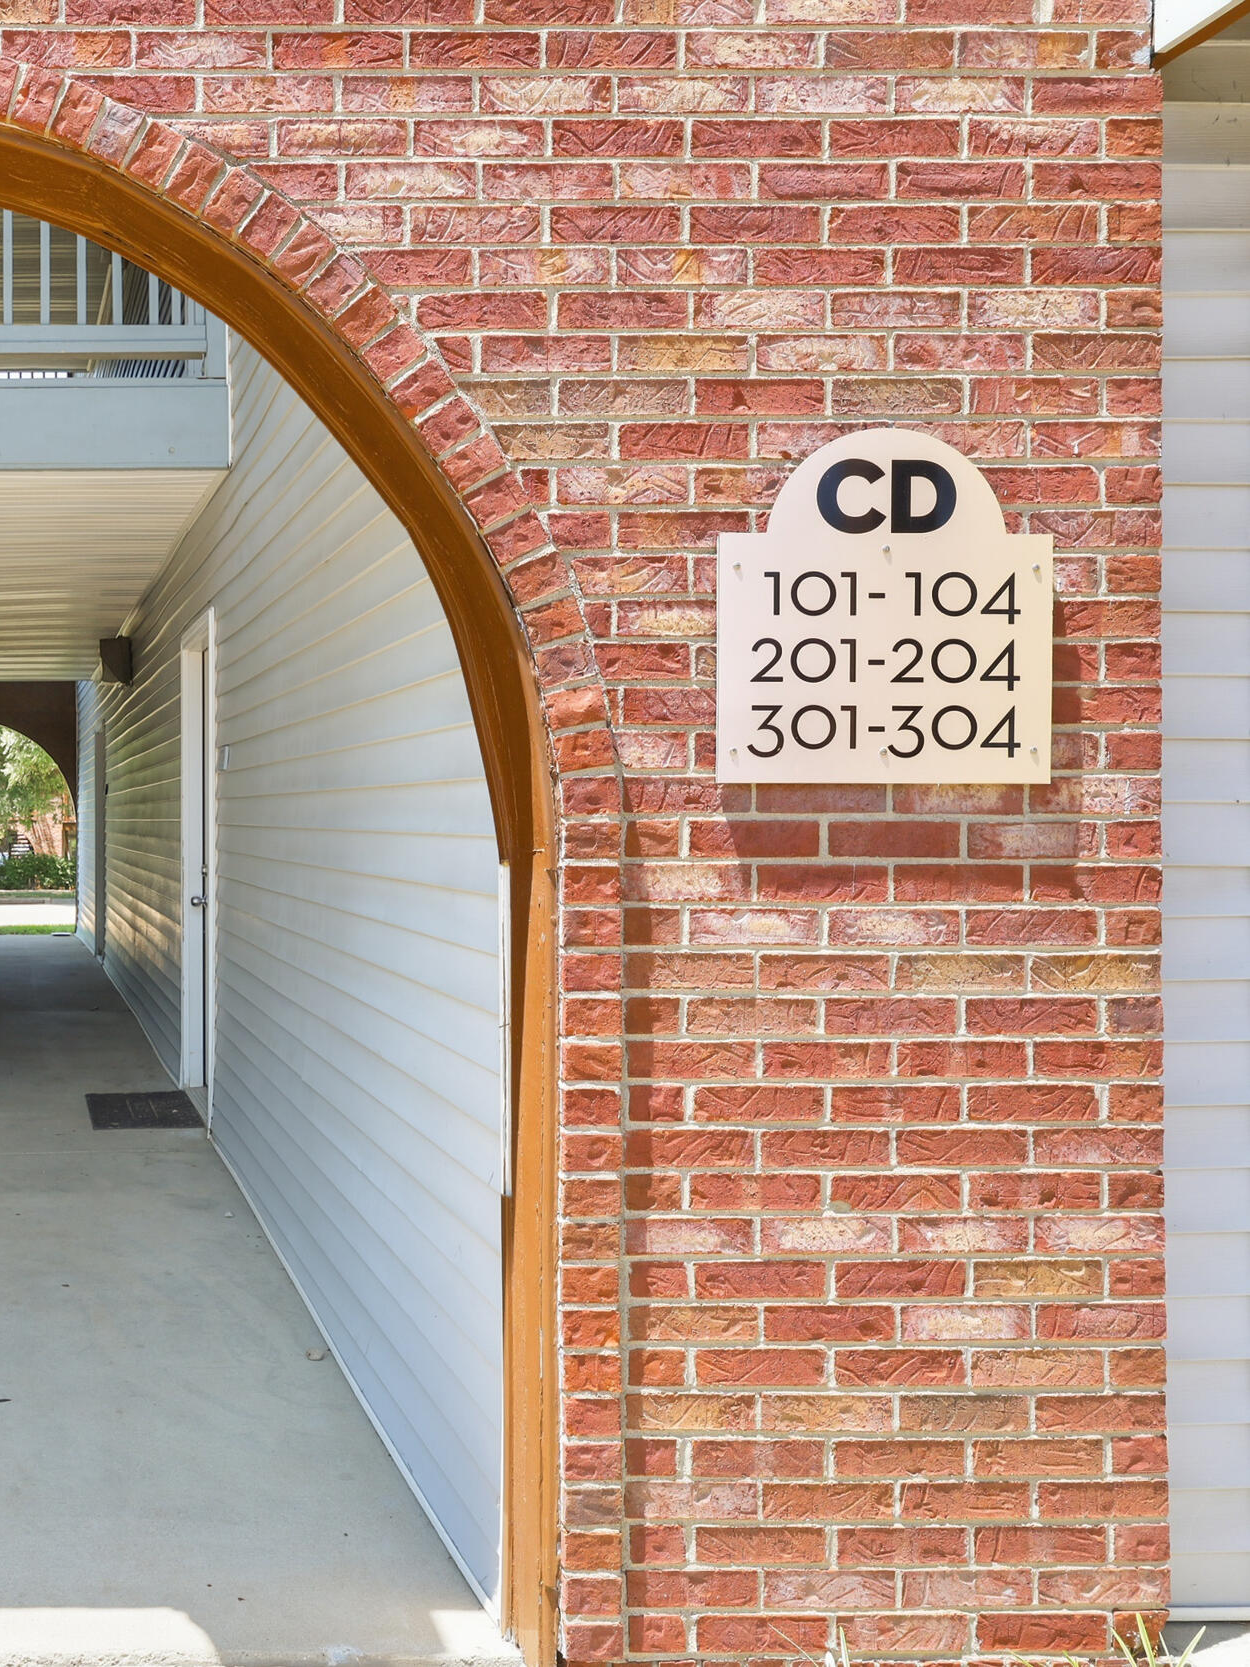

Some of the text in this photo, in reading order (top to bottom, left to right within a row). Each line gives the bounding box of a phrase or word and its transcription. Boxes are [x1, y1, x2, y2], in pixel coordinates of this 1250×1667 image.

[816, 458, 957, 534] CD
[750, 637, 1021, 692] 201-204
[747, 704, 1021, 759] 301-304
